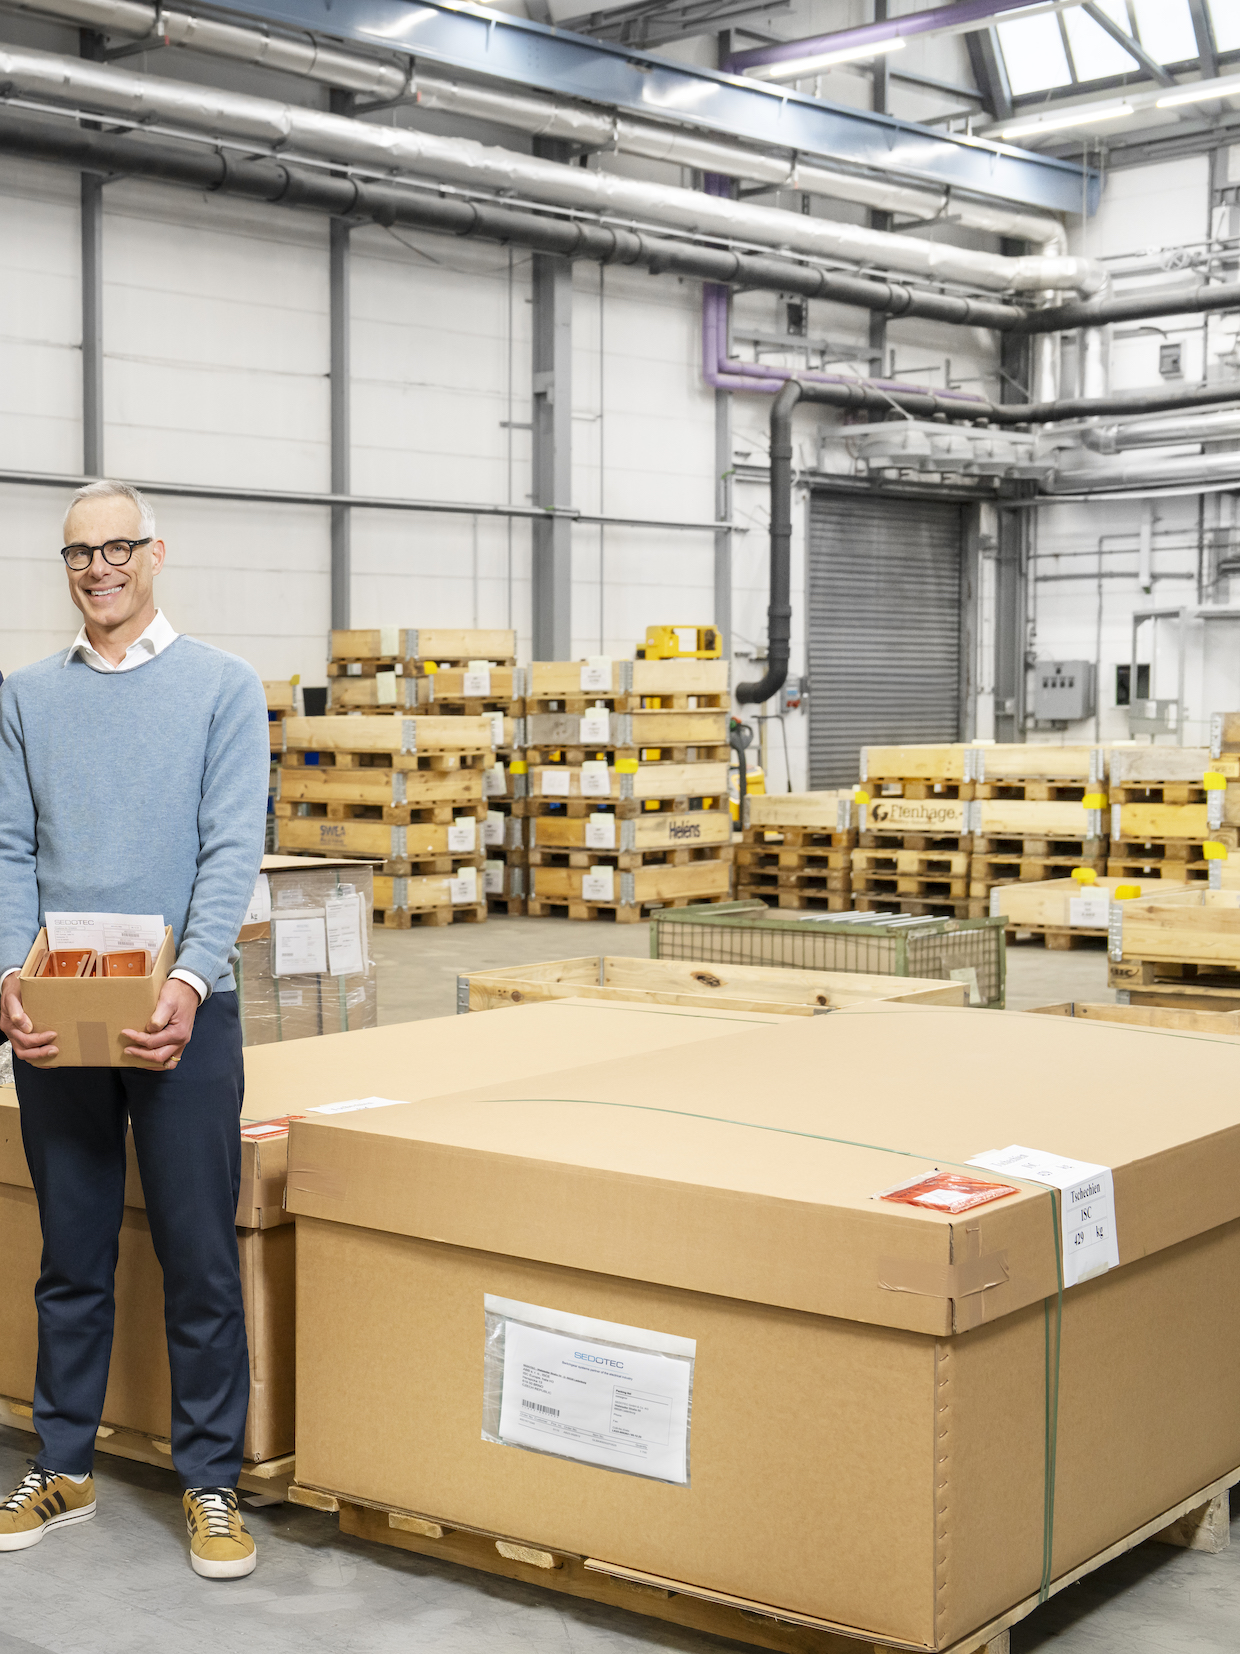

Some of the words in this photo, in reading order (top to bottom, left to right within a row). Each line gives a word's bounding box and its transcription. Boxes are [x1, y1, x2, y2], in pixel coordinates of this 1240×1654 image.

[1071, 1183, 1101, 1203] Tschechien
[1081, 1206, 1092, 1221] ISC
[1074, 1231, 1085, 1246] 429
[1095, 1225, 1105, 1240] kg
[574, 1352, 624, 1369] SEDOTEC
